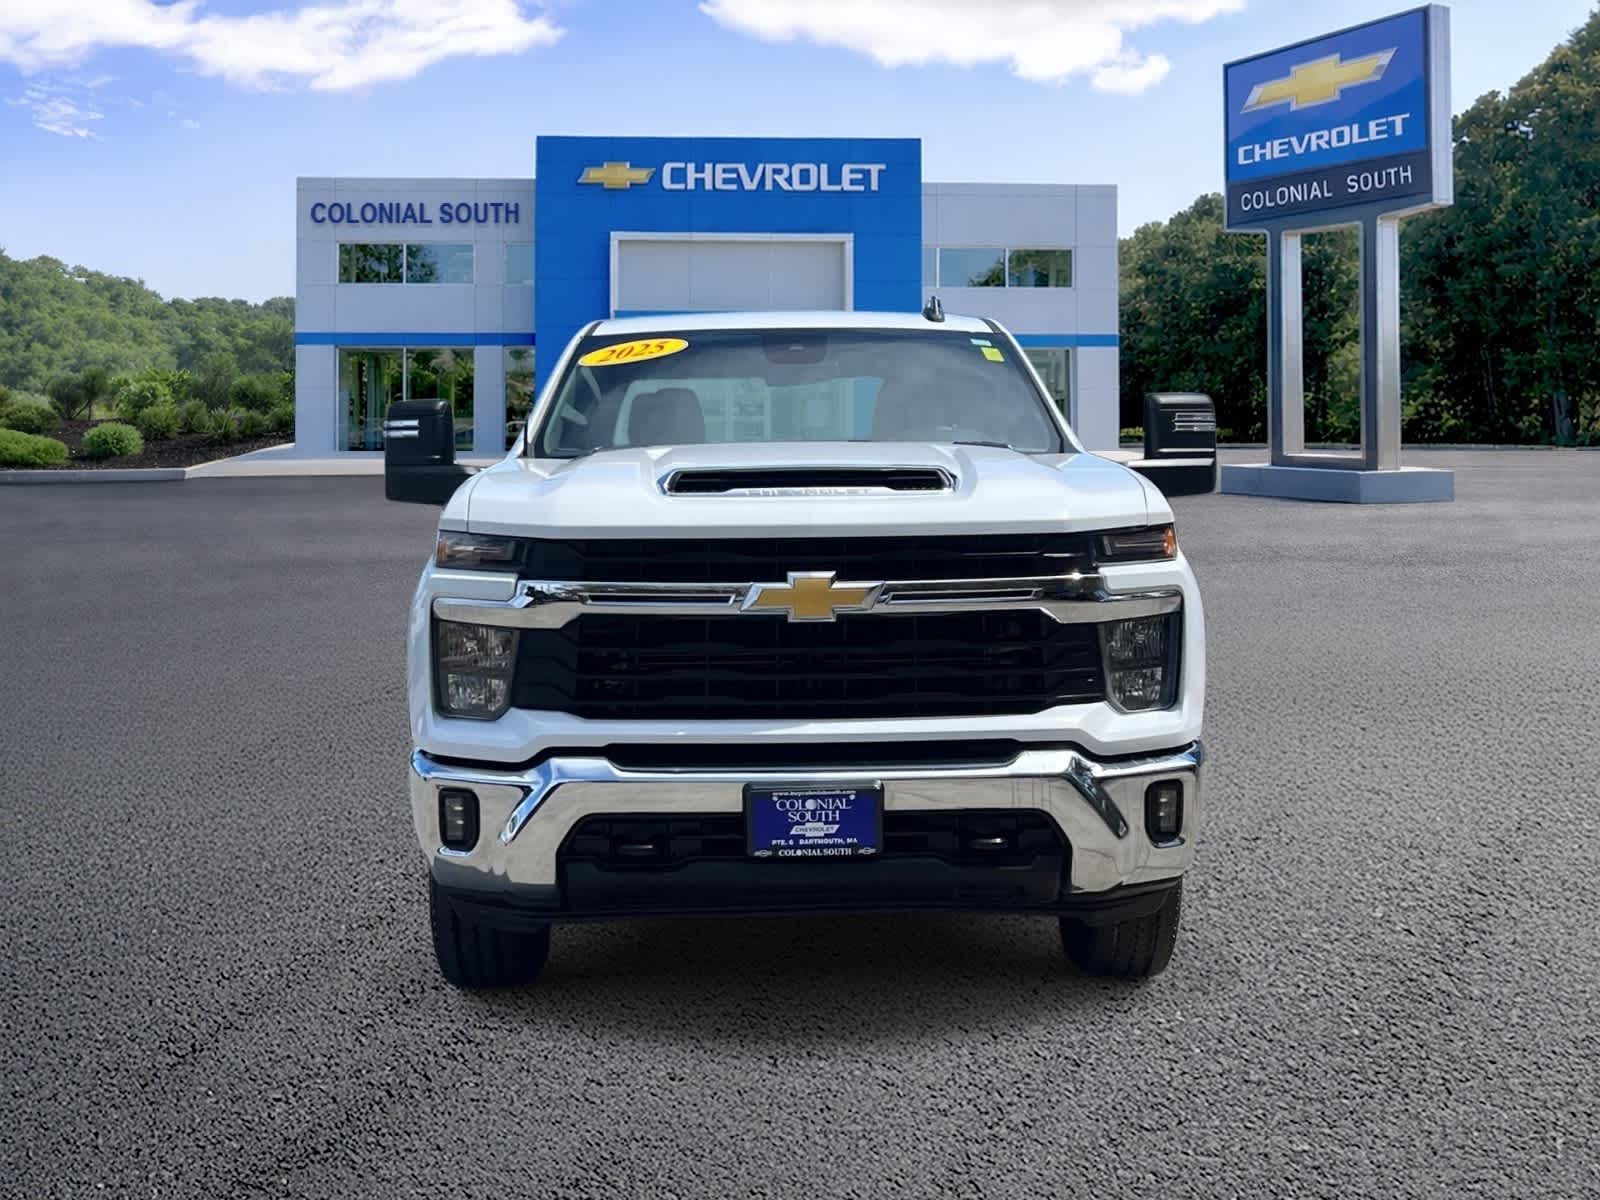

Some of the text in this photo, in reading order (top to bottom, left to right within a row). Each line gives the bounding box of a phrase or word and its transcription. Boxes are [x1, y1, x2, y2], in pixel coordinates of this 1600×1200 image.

[1237, 113, 1410, 165] CHEVROLET
[662, 162, 887, 191] CHEVROLET
[1241, 165, 1413, 211] COLONIAL SOUTH
[310, 202, 520, 224] COLONIAL SOUTH
[597, 341, 670, 363] 2025
[788, 810, 840, 822] SOUTH
[778, 847, 852, 857] COLONIAL SOUTH
